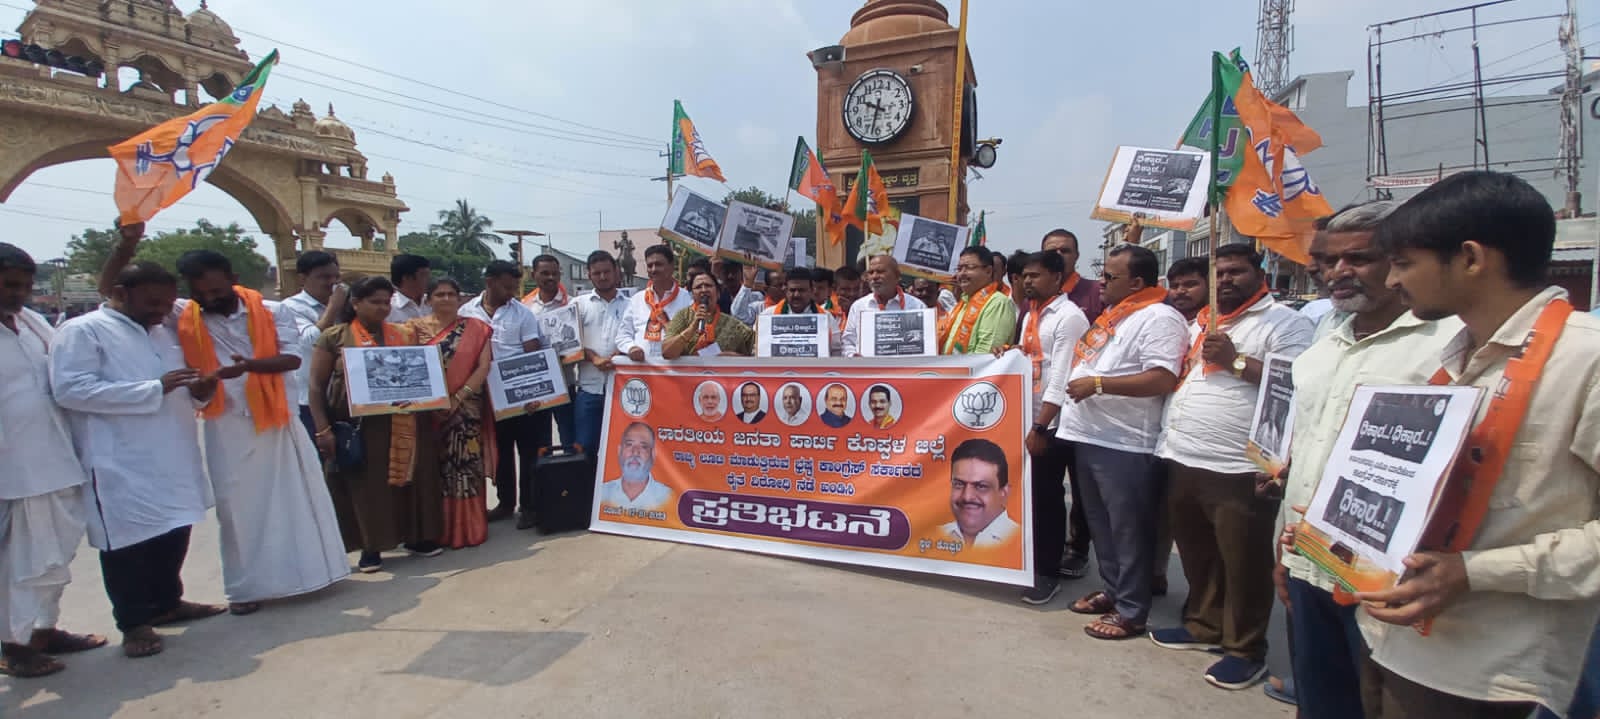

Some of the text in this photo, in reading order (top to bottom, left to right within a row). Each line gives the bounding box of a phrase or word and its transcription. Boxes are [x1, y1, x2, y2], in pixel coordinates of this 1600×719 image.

[872, 80, 883, 89] 12
[885, 81, 891, 90] 1
[865, 85, 872, 95] 11
[894, 88, 901, 98] 2
[856, 95, 866, 105] 10
[898, 100, 904, 109] 3
[852, 106, 859, 115] 9
[894, 111, 900, 121] 4
[856, 117, 862, 127] 8
[886, 122, 892, 131] 5
[865, 124, 871, 133] 7
[875, 126, 881, 136] 6
[657, 426, 946, 462] ಭಾರತೀಯ ಜನತಾ ಪಾರ್ಟಿ ಕೊಪ್ಪಳ ಜಿಲ್ಲೆ
[819, 459, 867, 477] ಕಾಂಗ್ರೆಸ್
[870, 462, 923, 478] ಸರ್ಕಾರದ
[750, 474, 792, 492] ವಿರೋಧಿ
[796, 477, 815, 492] ನಡೆ
[691, 496, 891, 538] ಪ್ರತಿಭಟನೆ
